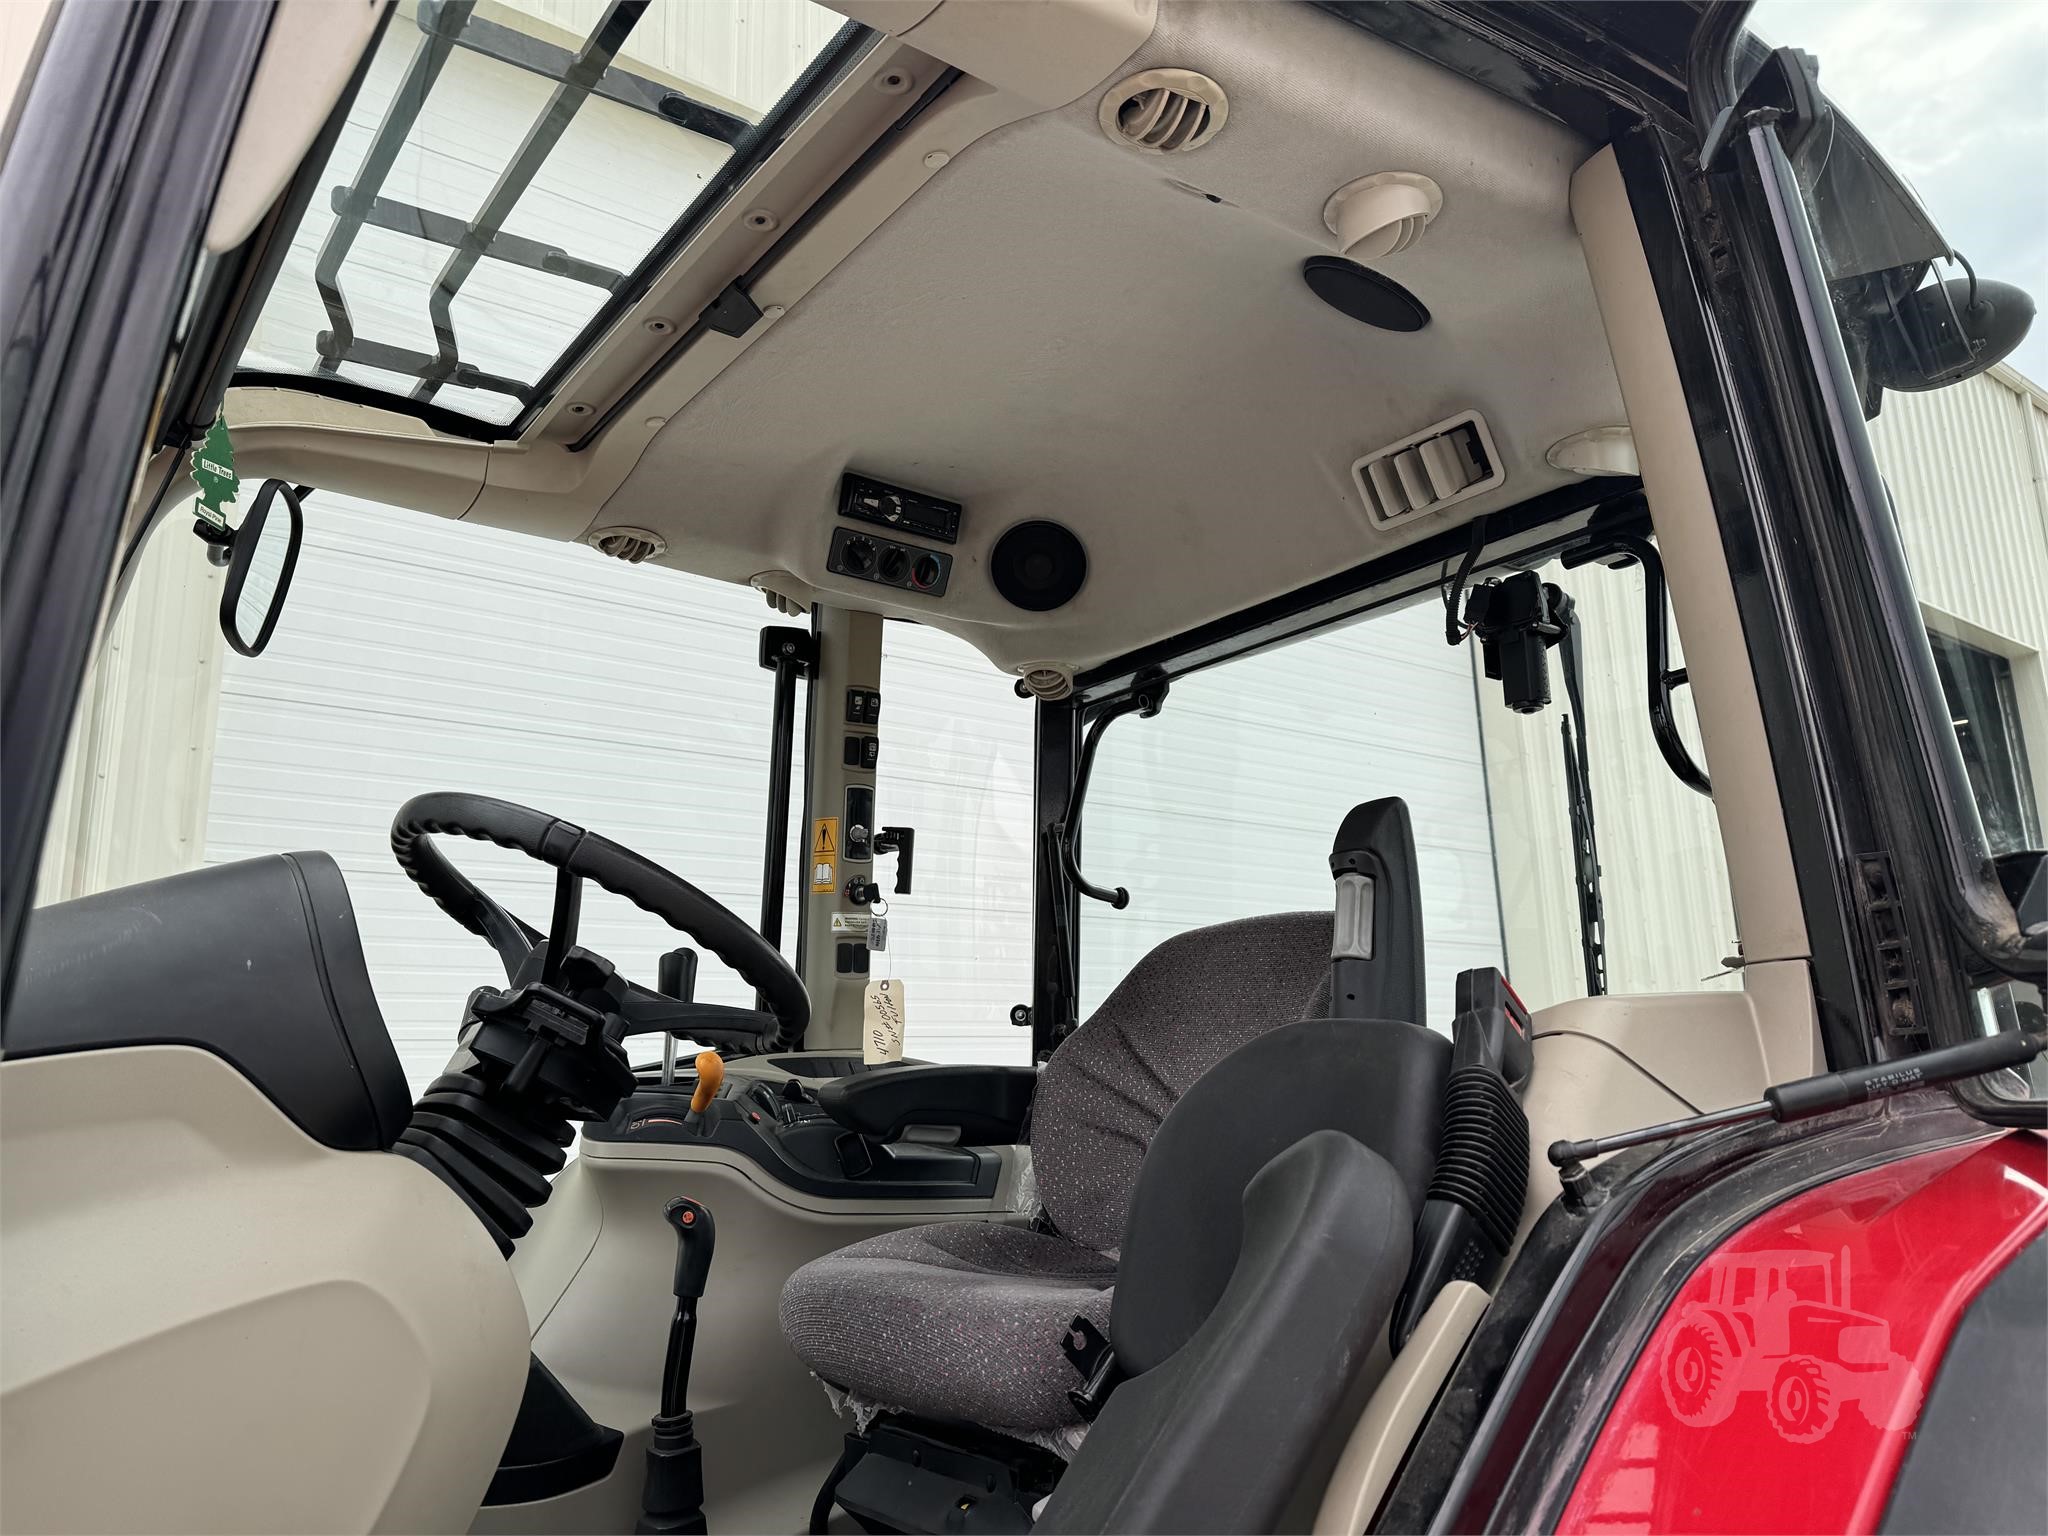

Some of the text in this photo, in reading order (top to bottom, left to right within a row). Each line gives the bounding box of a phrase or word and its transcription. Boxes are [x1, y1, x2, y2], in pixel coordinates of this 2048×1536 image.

[203, 459, 232, 479] Little Trees
[200, 505, 212, 518] Royal
[873, 1029, 889, 1055] 4710
[1865, 1067, 1921, 1086] STABILUS
